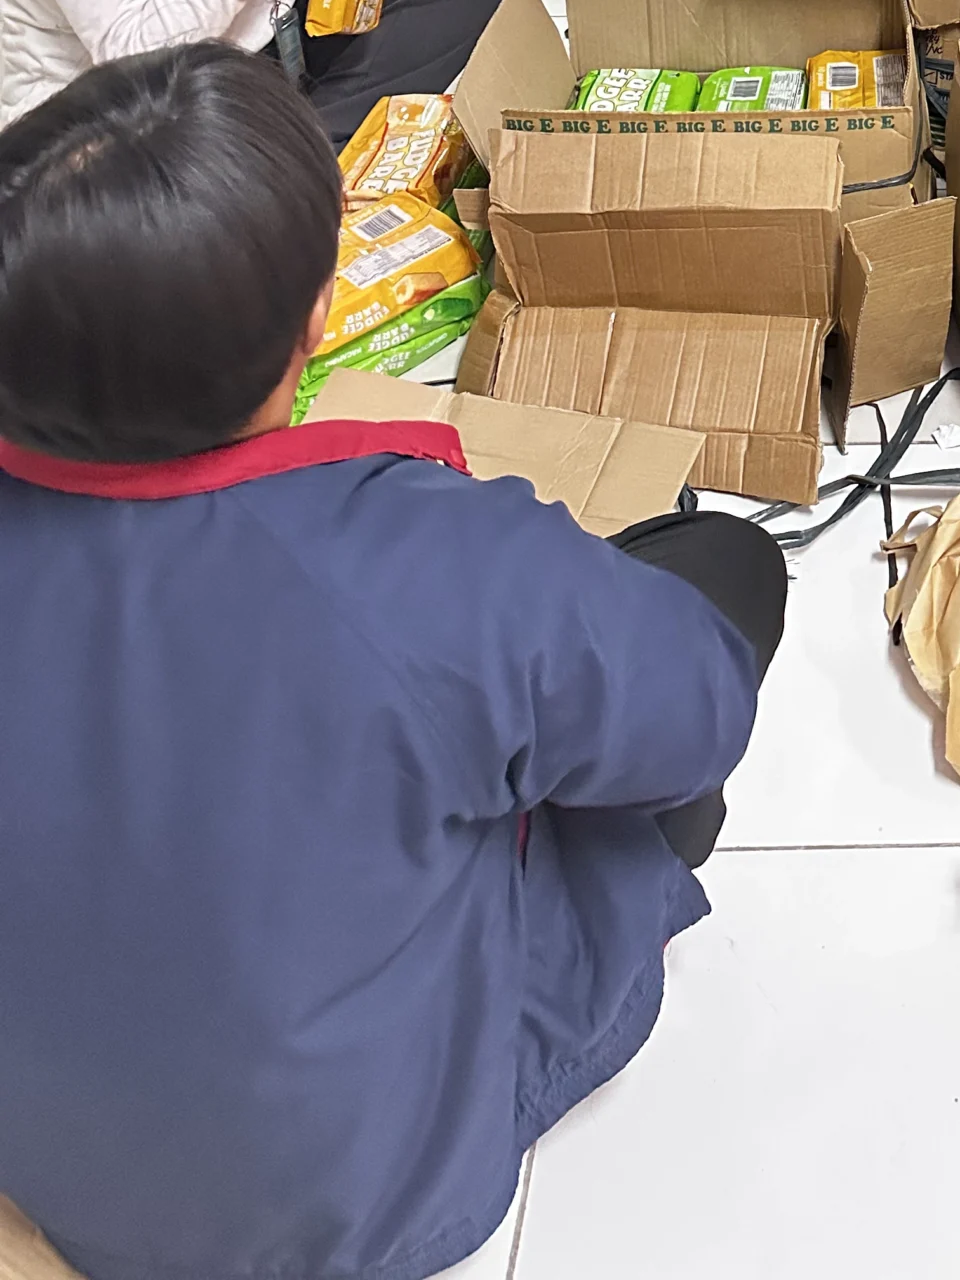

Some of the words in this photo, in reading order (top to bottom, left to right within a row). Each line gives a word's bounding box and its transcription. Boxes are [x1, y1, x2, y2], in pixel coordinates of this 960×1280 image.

[589, 68, 637, 111] DGEE
[615, 77, 652, 111] ARR
[505, 119, 535, 132] BIG
[539, 118, 555, 133] E
[562, 120, 591, 133] BIG
[596, 119, 612, 134] E
[619, 121, 648, 133] BIG
[654, 120, 669, 133] E
[676, 122, 705, 133] BIG
[711, 120, 726, 133] E
[733, 121, 762, 133] BIG
[768, 119, 783, 133] E
[790, 120, 820, 132] BIG
[825, 118, 839, 132] E
[847, 118, 876, 130] BIG
[881, 115, 895, 129] E
[383, 128, 437, 195] FUDGE
[341, 305, 391, 335] FUDGEE
[344, 301, 382, 325] BARR
